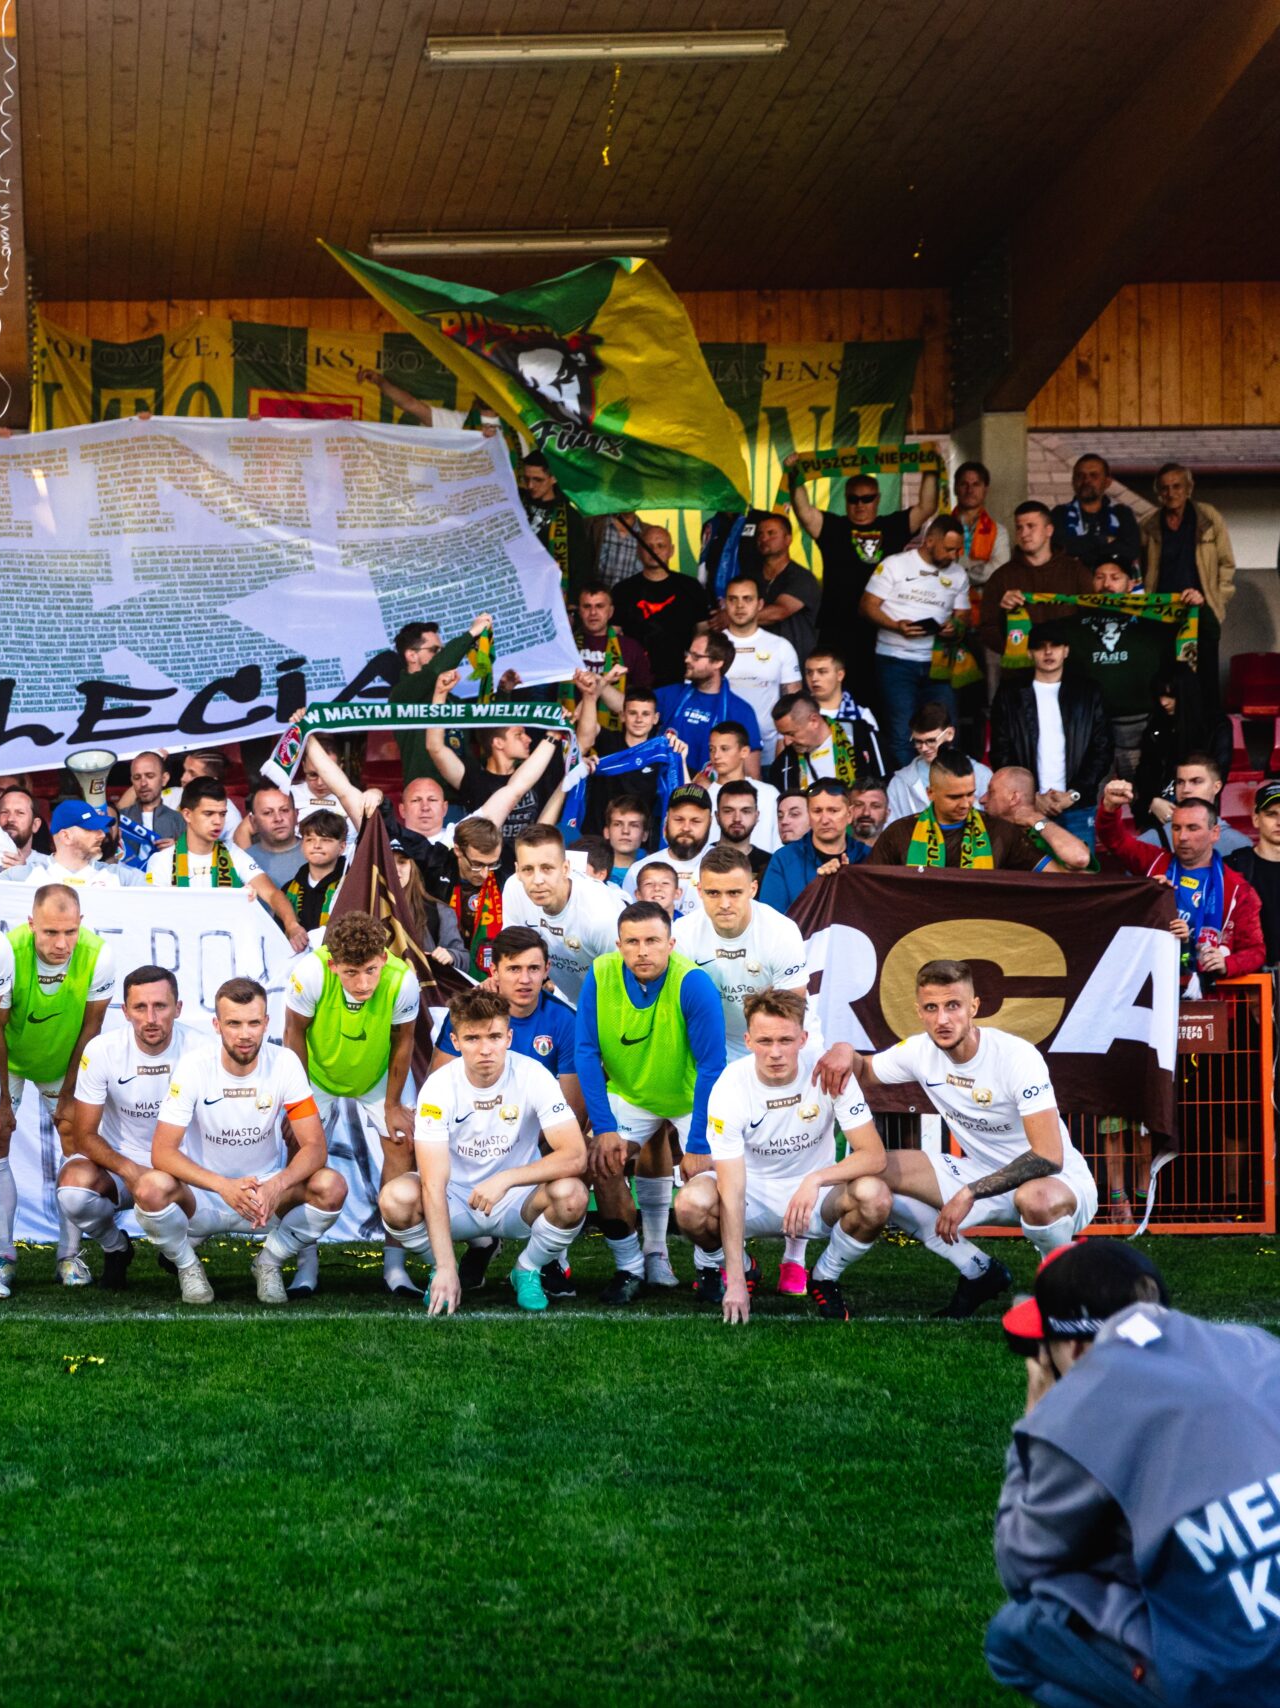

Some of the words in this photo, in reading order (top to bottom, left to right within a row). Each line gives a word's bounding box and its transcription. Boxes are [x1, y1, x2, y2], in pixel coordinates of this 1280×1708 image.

[802, 453, 871, 473] PUSZCZA
[1091, 650, 1129, 664] FANS
[303, 709, 322, 725] W
[323, 703, 393, 724] MAŁYM
[471, 702, 530, 718] WIELKI
[533, 704, 567, 724] KLU
[137, 1066, 169, 1074] FORTUNA
[223, 1089, 257, 1097] FORTUNA
[768, 1097, 800, 1108] FORTUNA
[221, 1127, 261, 1137] MIASTO
[473, 1135, 509, 1148] MIASTO
[769, 1133, 810, 1148] MIASTO
